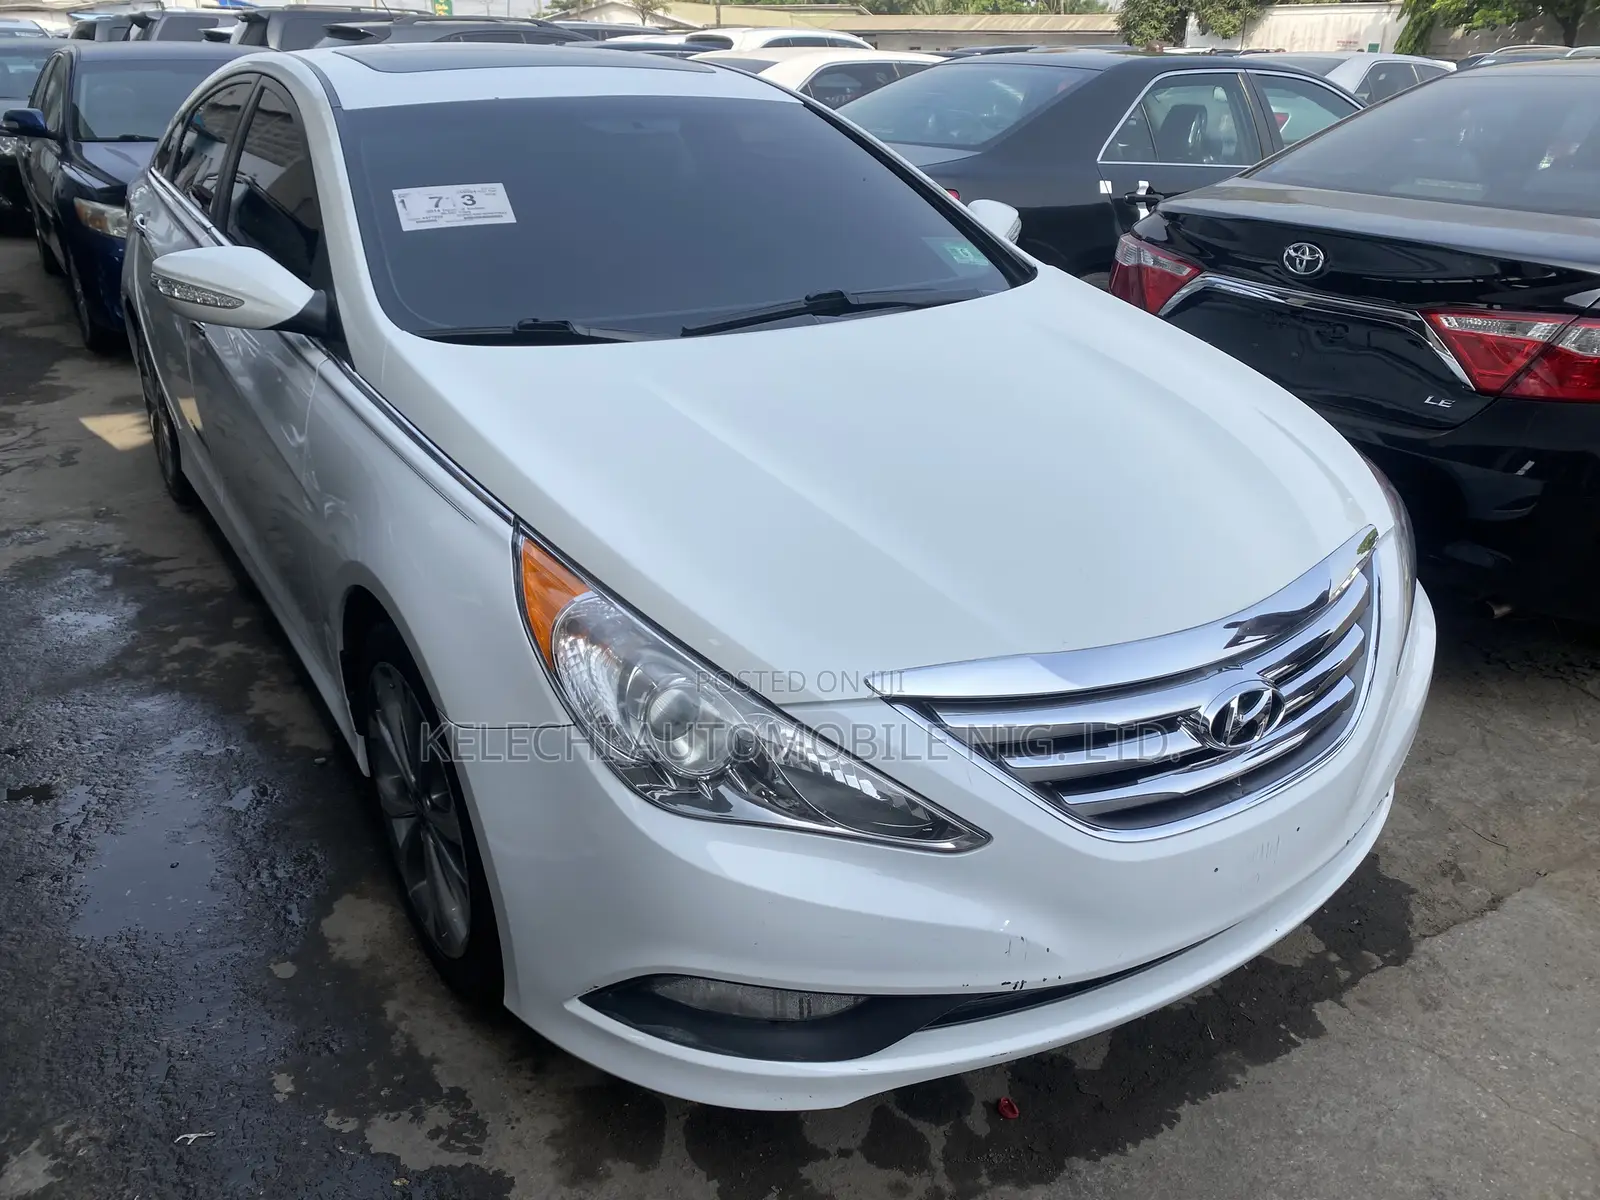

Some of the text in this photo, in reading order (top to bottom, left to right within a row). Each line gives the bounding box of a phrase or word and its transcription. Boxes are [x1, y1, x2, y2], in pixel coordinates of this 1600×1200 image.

[428, 196, 444, 208] 7
[461, 194, 477, 206] 3
[1423, 395, 1456, 408] LE
